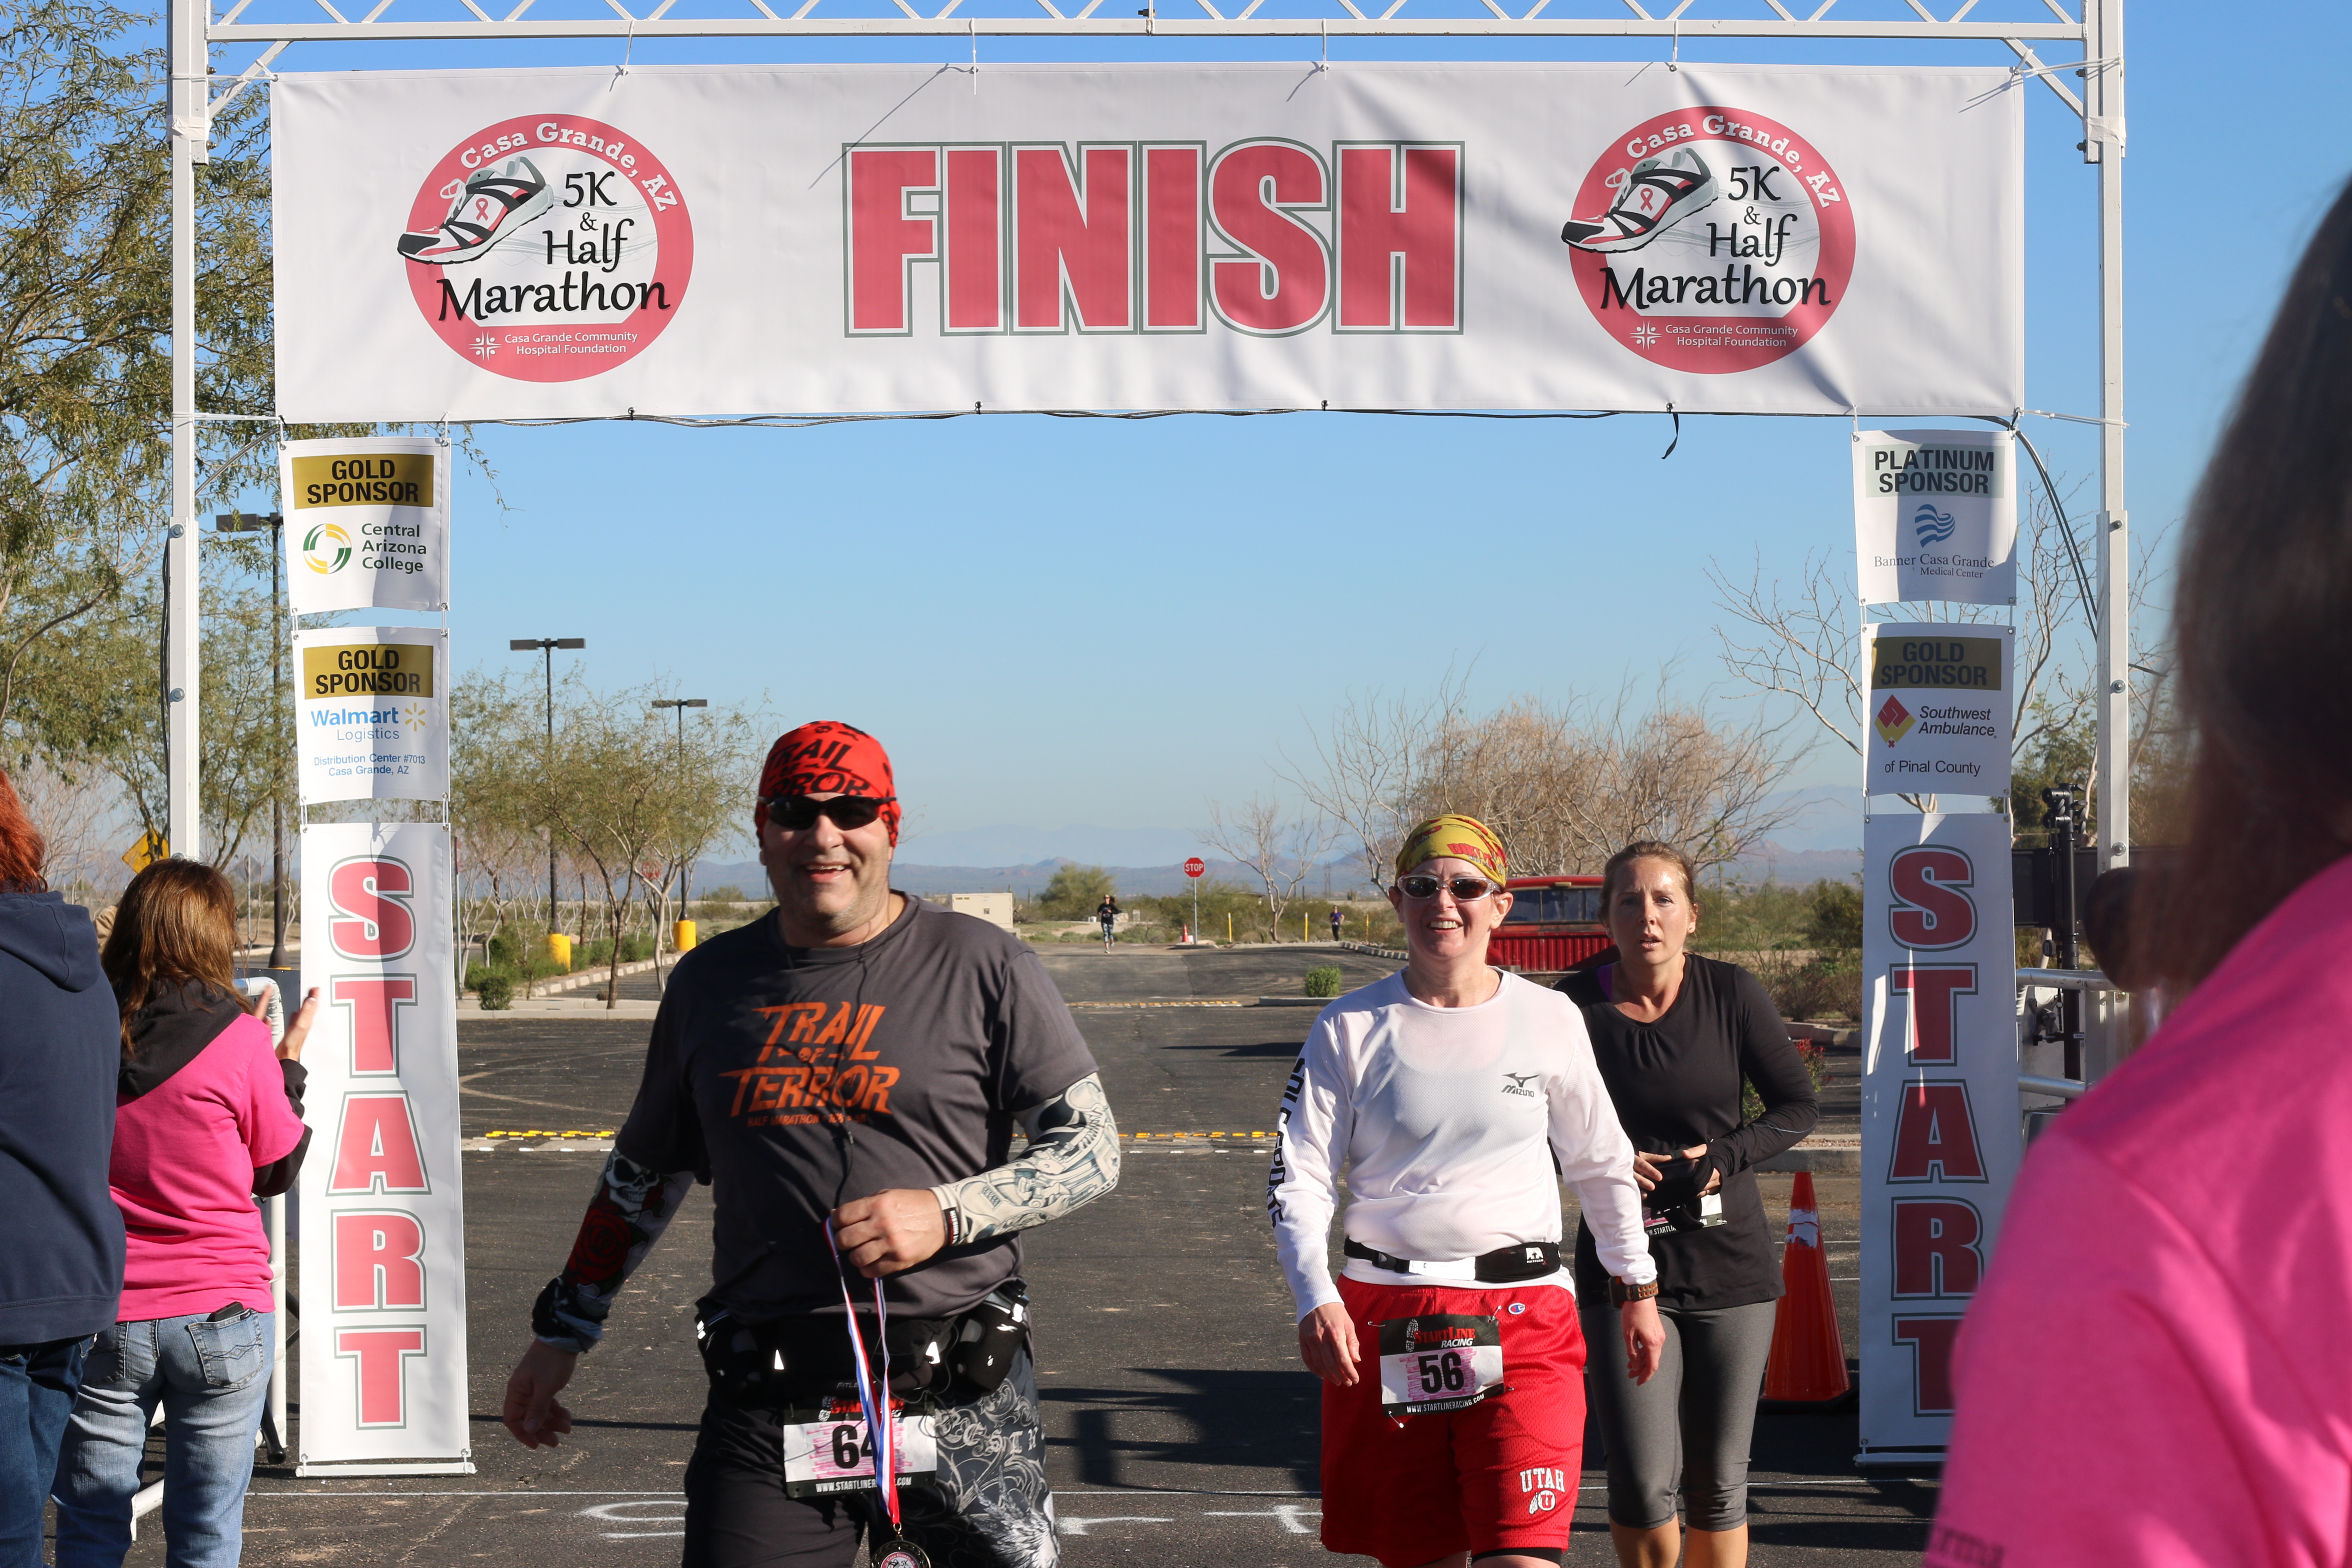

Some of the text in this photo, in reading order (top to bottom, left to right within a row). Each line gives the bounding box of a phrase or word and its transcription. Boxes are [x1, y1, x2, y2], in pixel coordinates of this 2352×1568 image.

[461, 122, 678, 212] Casa Grande, AZ
[1626, 115, 1841, 208] Casa Grande, AZ
[563, 171, 618, 208] 5K
[1727, 165, 1781, 201] 5K
[579, 212, 599, 231] &
[1743, 206, 1762, 226] &
[542, 218, 635, 273] Half
[842, 136, 1464, 338] FINISH
[1706, 213, 1798, 267] Half
[436, 271, 671, 321] Marathon
[1599, 263, 1831, 310] Marathon
[504, 331, 638, 344] Casa Grande Community
[1665, 324, 1798, 337] Casa Grande Community
[516, 343, 627, 357] Hospital Foundation
[1677, 336, 1787, 348] Hospital Foundation
[332, 459, 395, 480] GOLD
[1874, 449, 1994, 472] PLATINUM
[307, 481, 419, 504] SPONSOR
[1879, 472, 1989, 494] SPONSOR
[361, 523, 420, 537] Central
[361, 539, 427, 554] Arizona
[362, 556, 423, 574] College
[1874, 553, 1994, 568] Banner Casa Grande
[1920, 567, 1983, 578] Medical Center
[338, 649, 399, 671] GOLD
[1902, 642, 1965, 662] GOLD
[315, 672, 421, 695] SPONSOR
[1880, 665, 1987, 686] SPONSOR
[311, 707, 399, 727] Walmart
[1919, 705, 1991, 721] Southwest
[337, 727, 400, 743] Logistics
[1918, 721, 1995, 736] Ambulance
[314, 753, 425, 766] Distribution Center #7013
[1885, 760, 1981, 777] of Pinal County
[329, 764, 409, 776] Casa Grande, AZ
[1185, 864, 1203, 872] STOP
[751, 1001, 886, 1065] TRAIL
[718, 1064, 900, 1117] TERROR
[325, 854, 431, 1430] START
[1441, 1338, 1473, 1348] RACING
[1418, 1352, 1464, 1393] 56
[1406, 1393, 1485, 1413] WWW.STARTLINERACING.COM
[1519, 1467, 1565, 1493] UTAH
